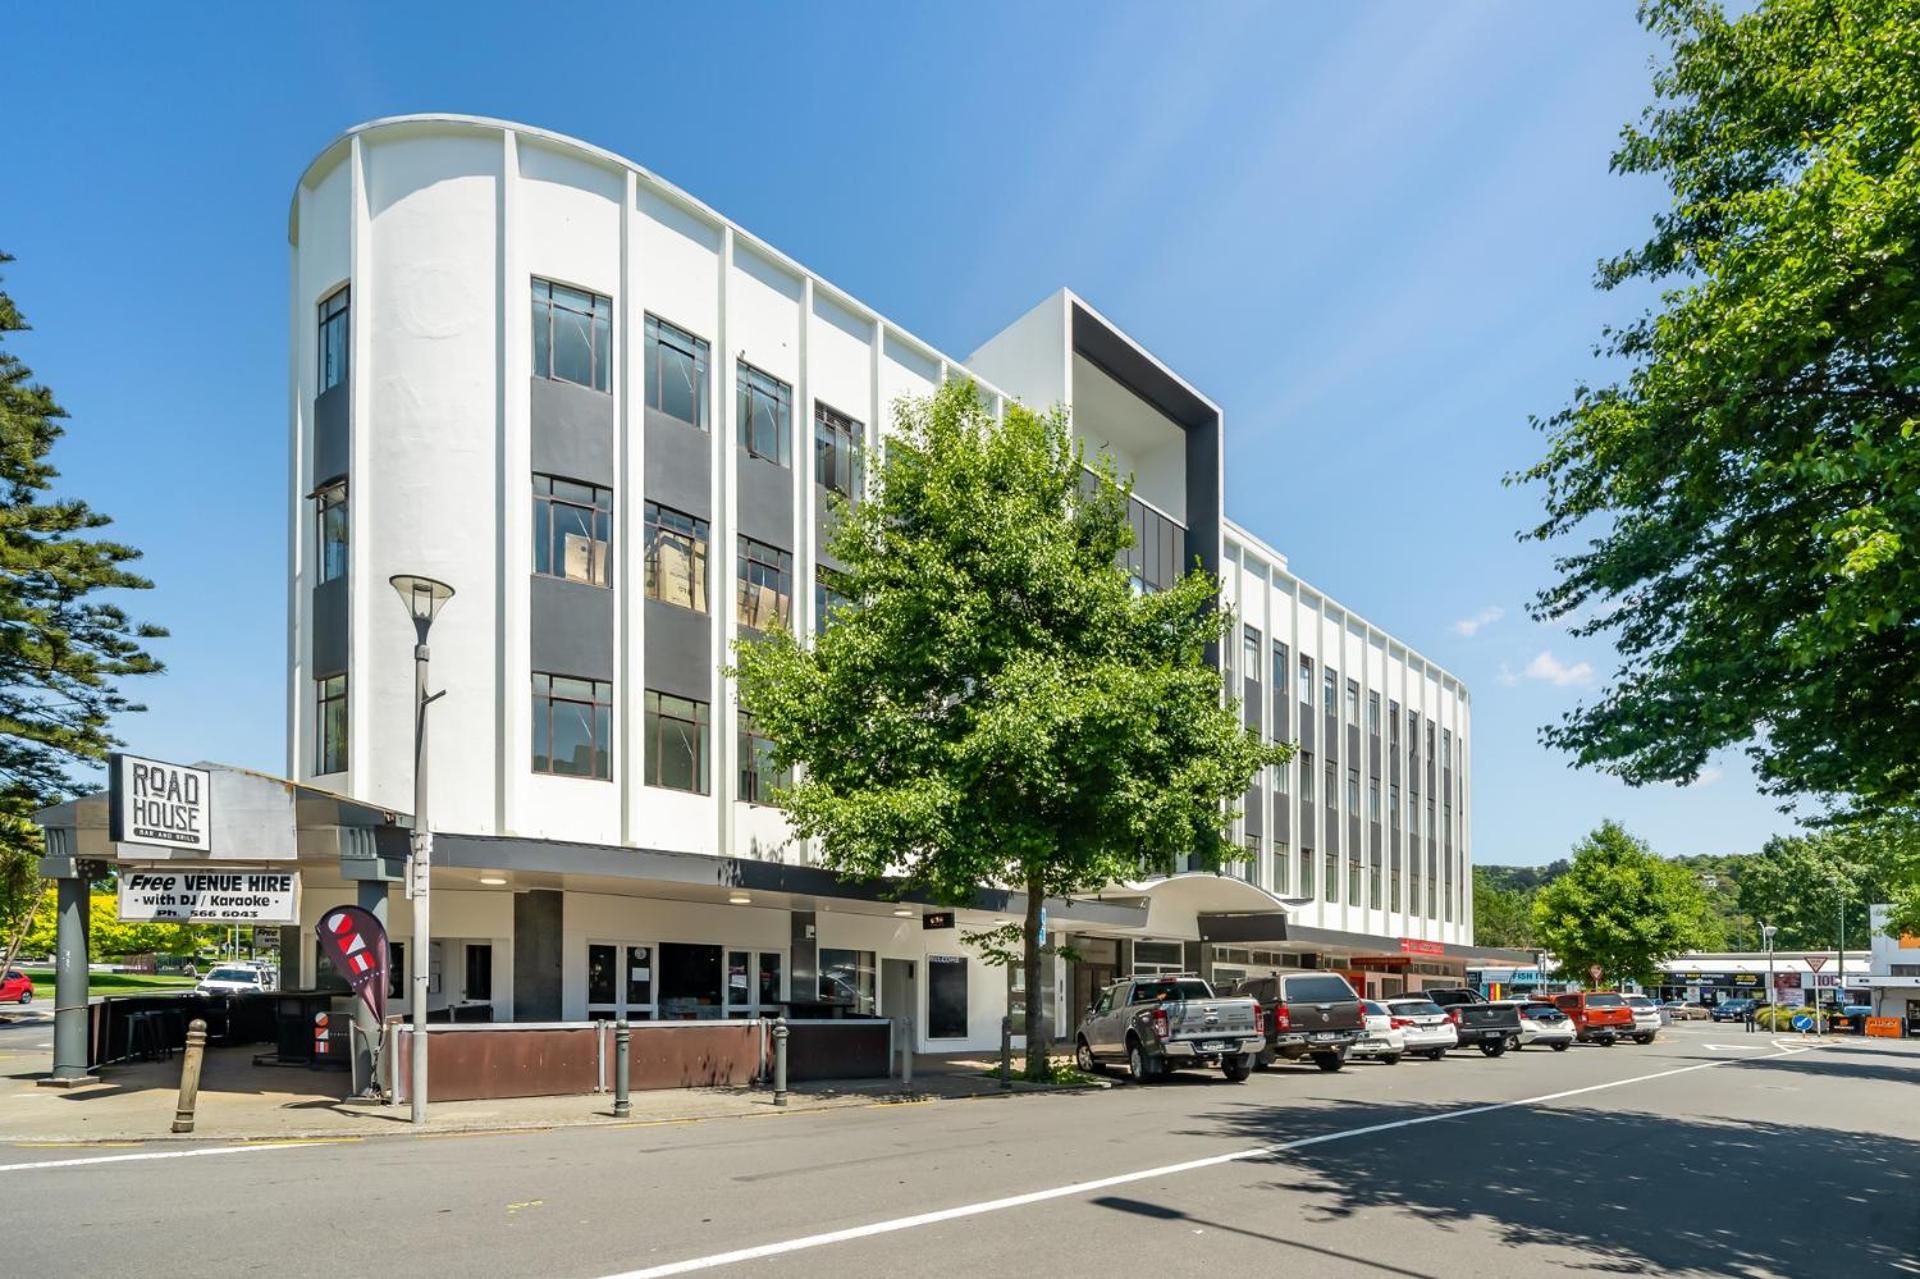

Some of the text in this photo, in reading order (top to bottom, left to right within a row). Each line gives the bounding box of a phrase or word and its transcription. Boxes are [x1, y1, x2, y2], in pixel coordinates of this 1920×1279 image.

[133, 763, 199, 805] ROAD
[133, 798, 200, 833] HOUSE
[158, 831, 172, 839] AND
[129, 874, 291, 892] Free VENUE HIRE
[143, 894, 176, 906] with
[180, 894, 197, 906] DJ
[210, 894, 270, 907] Karaoke
[190, 910, 217, 918] 566
[221, 910, 259, 918] 6043
[1512, 972, 1533, 980] FISH
